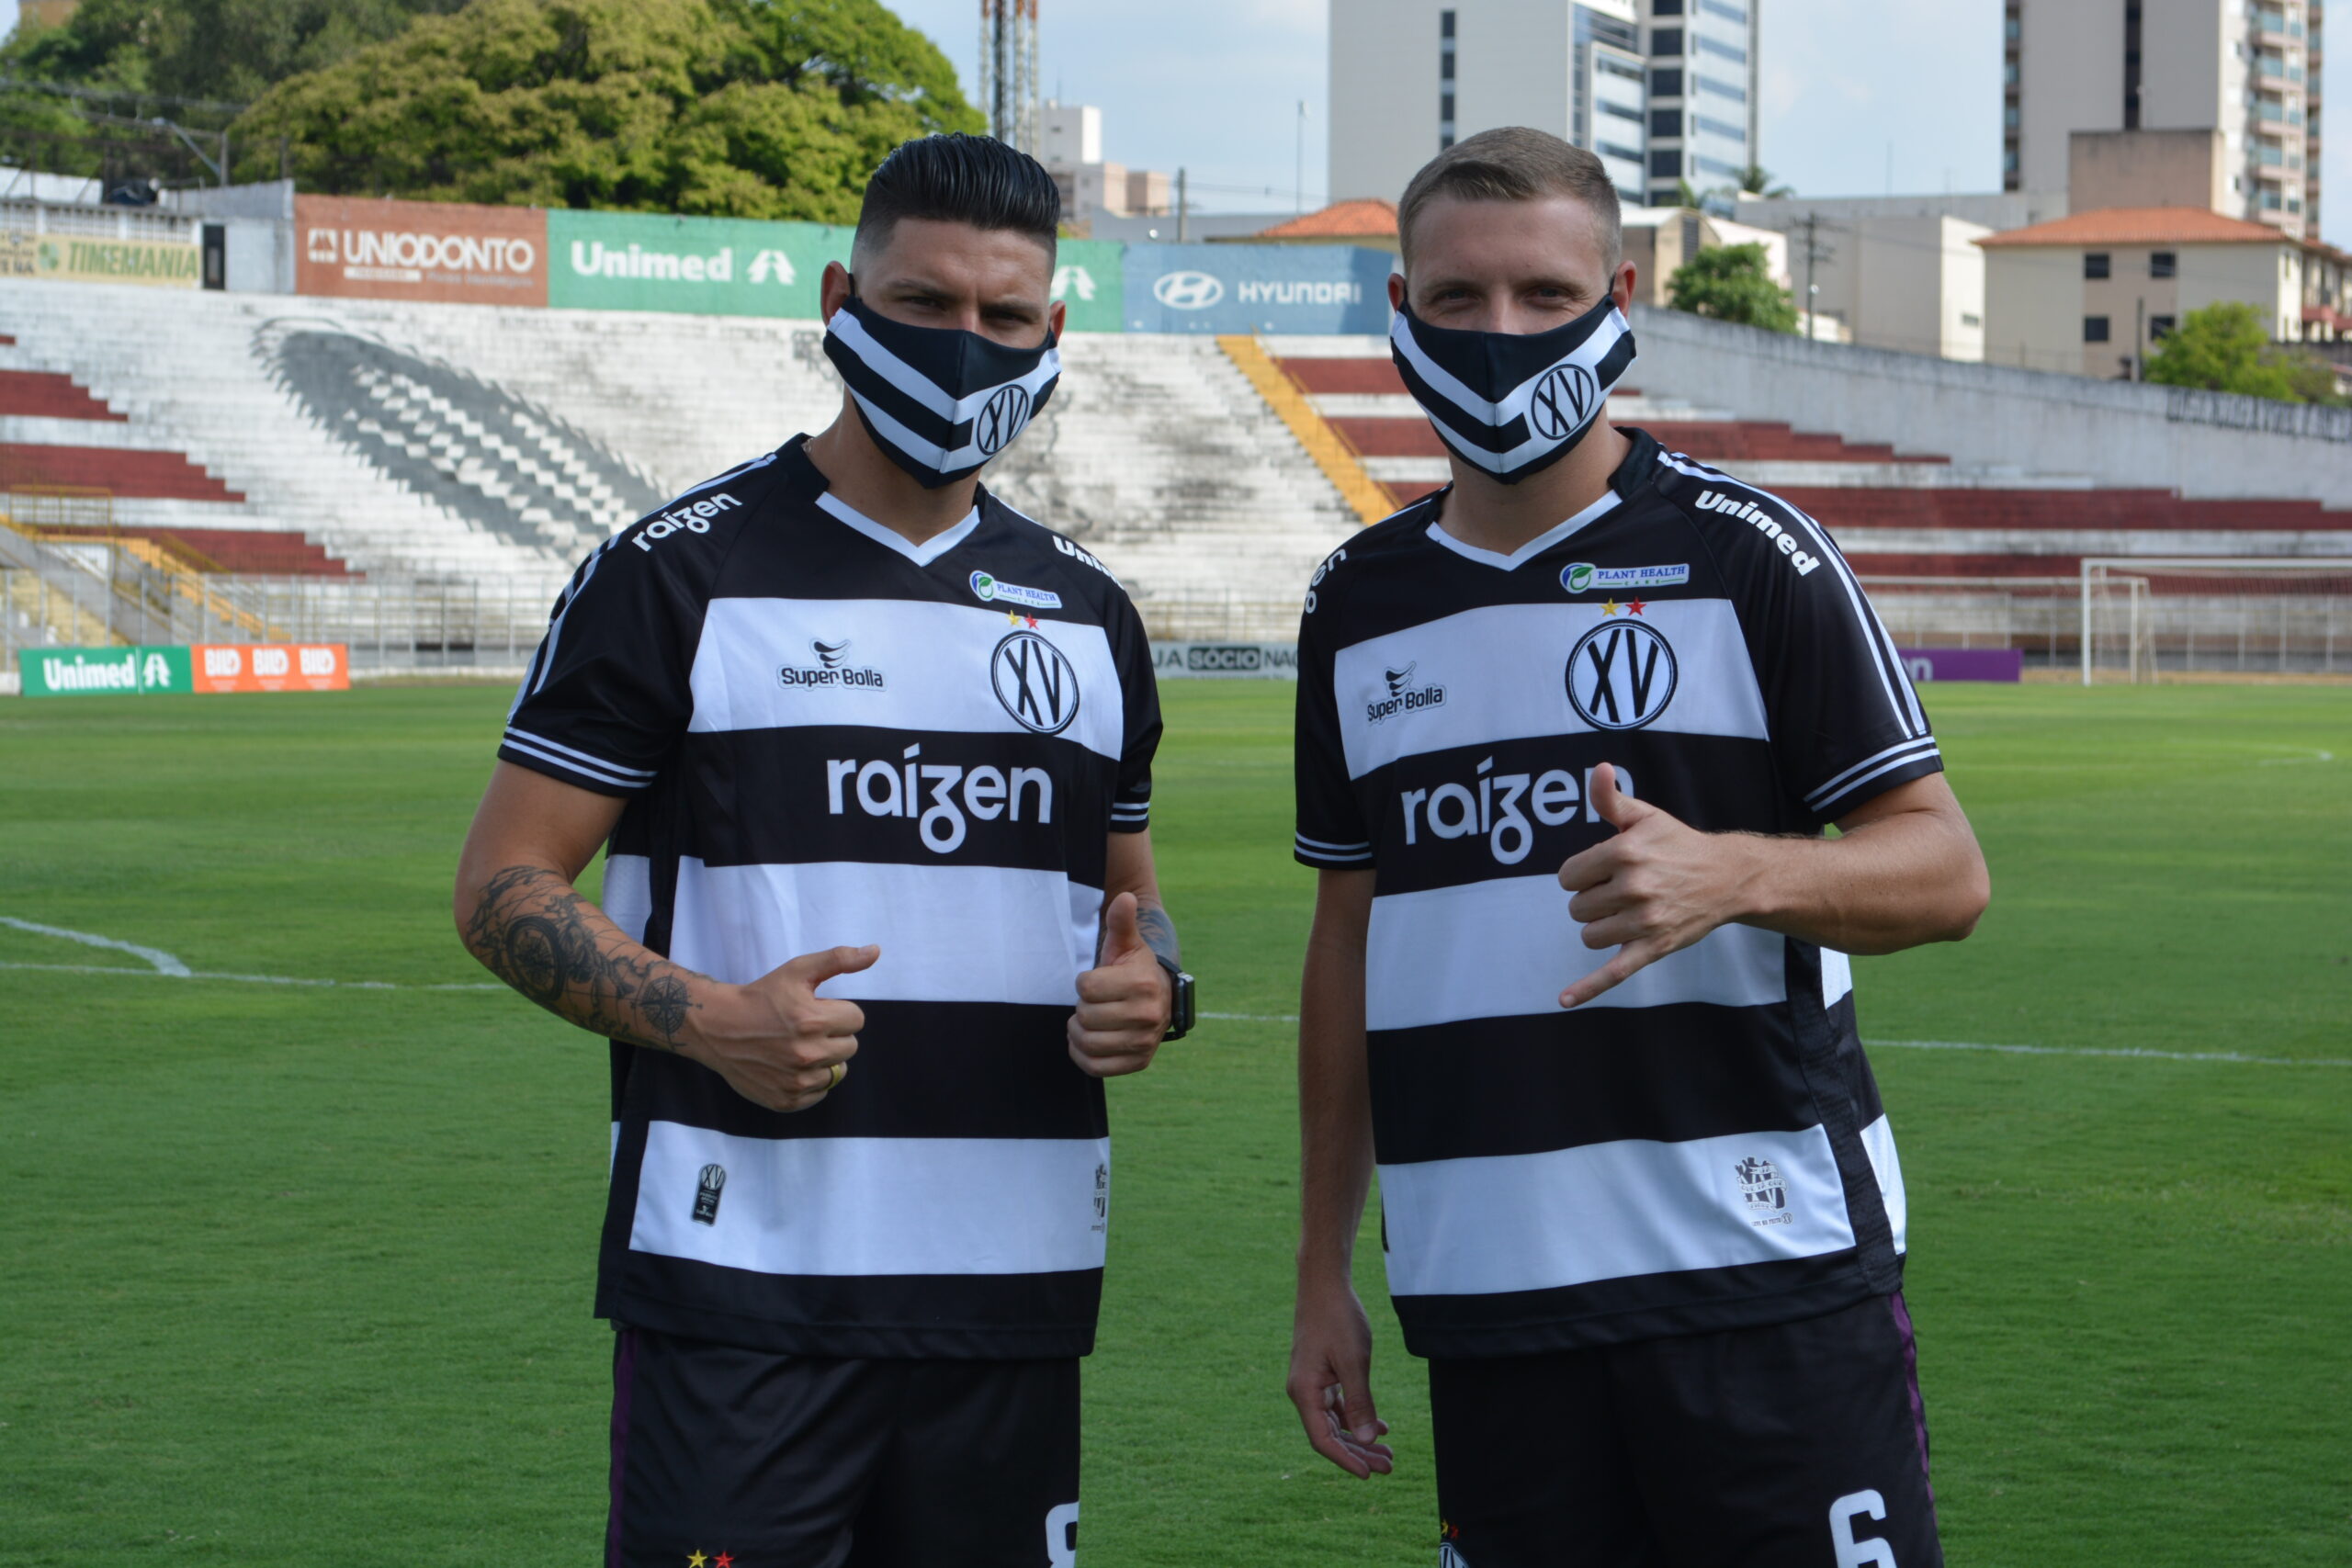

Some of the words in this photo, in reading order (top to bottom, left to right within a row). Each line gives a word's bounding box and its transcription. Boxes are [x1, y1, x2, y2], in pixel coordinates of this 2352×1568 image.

[67, 242, 198, 278] TIMEMANIA
[343, 230, 536, 274] UNIODONTO
[571, 241, 732, 282] Unimed
[1238, 281, 1363, 304] HYUNDAI
[983, 389, 1025, 451] XV
[1534, 369, 1584, 436] XV
[1694, 490, 1821, 577] Unimed
[1598, 570, 1636, 580] PLANT
[1639, 566, 1686, 579] HEALTH
[996, 583, 1023, 597] PLANT
[1024, 589, 1057, 603] HEALTH
[43, 653, 137, 690] Unimed
[781, 667, 840, 688] Super
[842, 668, 884, 688] Bolla
[1003, 638, 1060, 727] XV
[1587, 628, 1659, 724] XV
[1367, 697, 1403, 722] Super
[1405, 687, 1443, 710] Bolla
